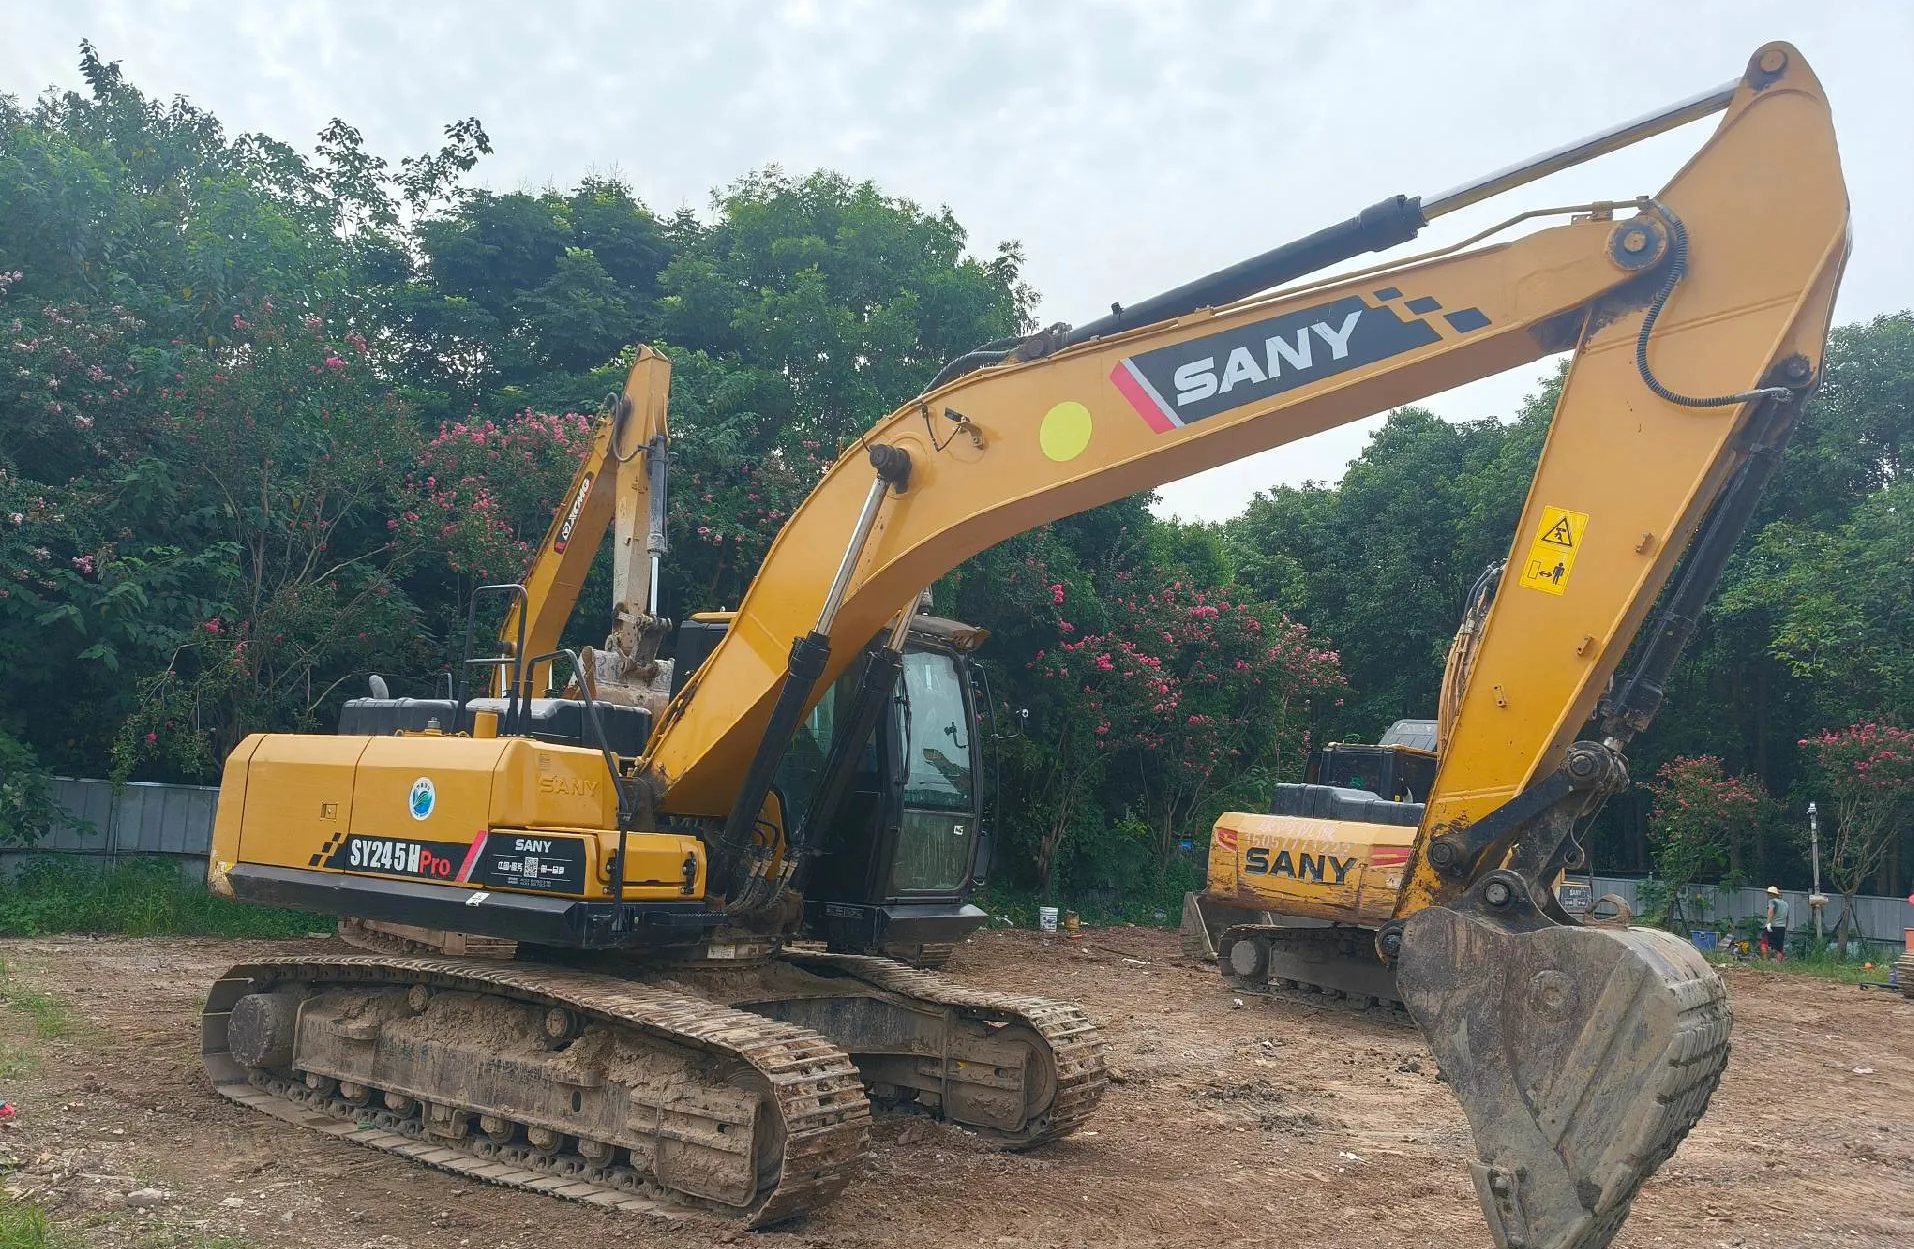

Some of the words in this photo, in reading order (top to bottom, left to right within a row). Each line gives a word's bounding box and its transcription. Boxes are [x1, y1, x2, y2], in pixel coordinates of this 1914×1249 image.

[1174, 310, 1362, 406] SANY
[568, 478, 589, 528] XCMG
[541, 777, 599, 797] SANY
[515, 838, 552, 854] SANY
[1245, 847, 1357, 884] SANY
